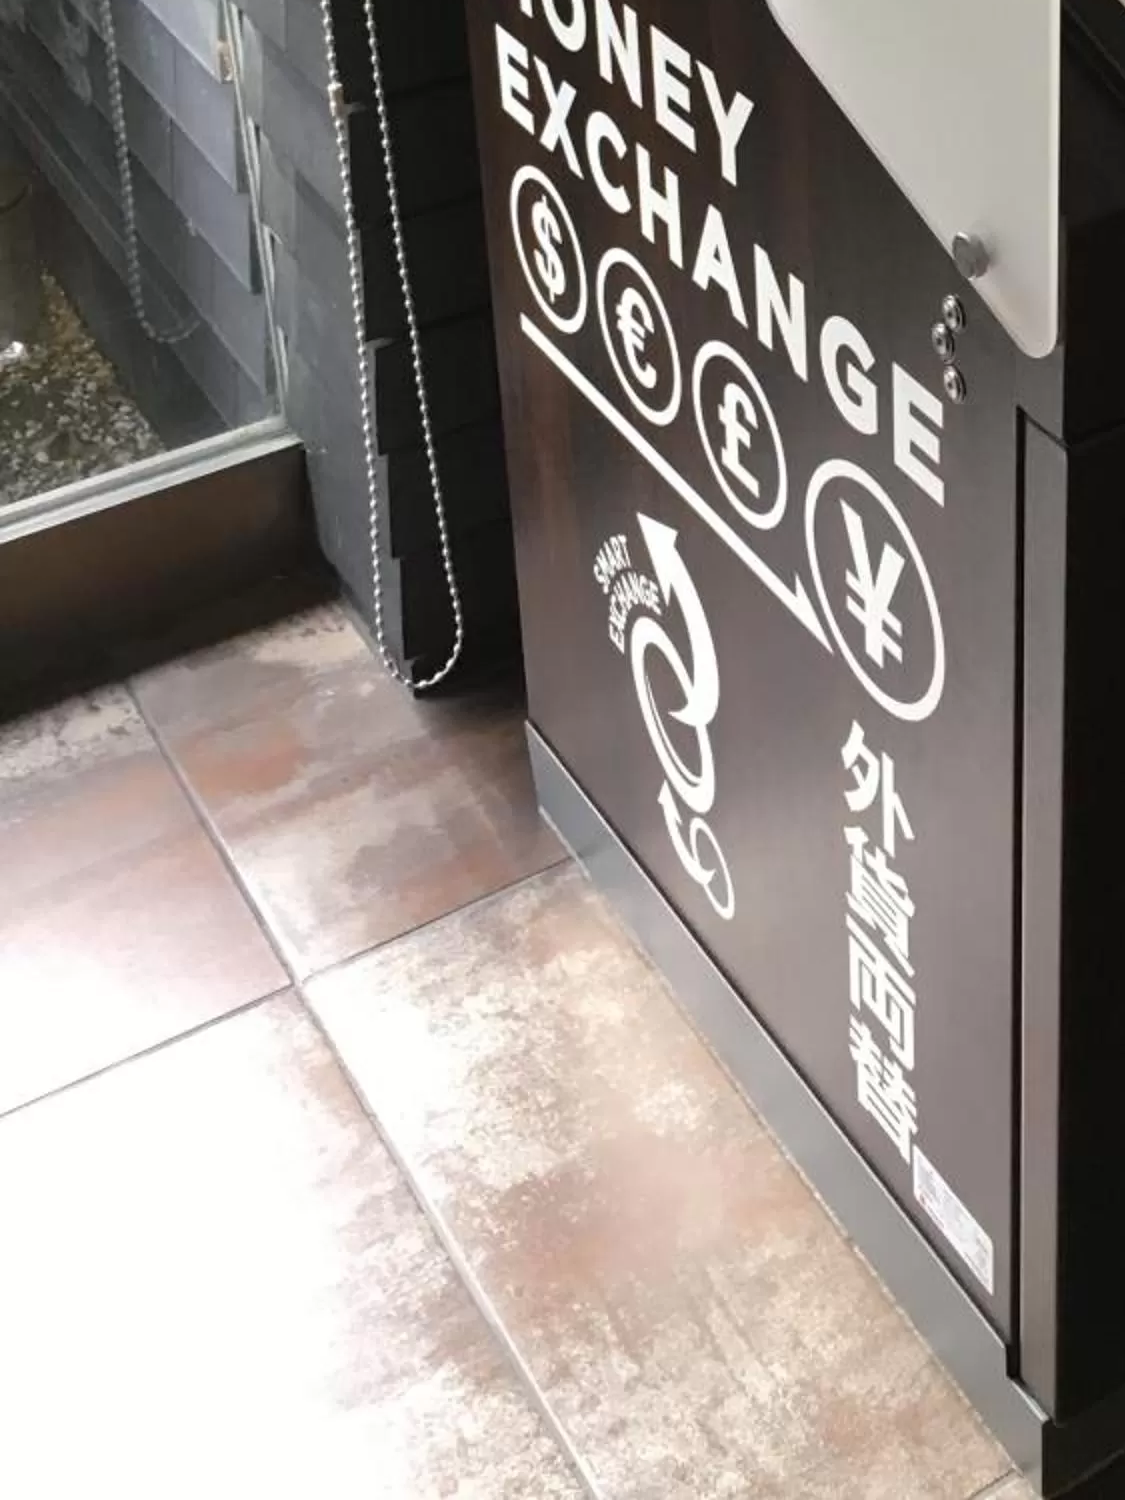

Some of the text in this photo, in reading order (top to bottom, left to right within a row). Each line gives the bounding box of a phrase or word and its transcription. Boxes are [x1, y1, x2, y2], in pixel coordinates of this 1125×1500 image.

[494, 23, 946, 508] EXCHANGE
[593, 534, 632, 595] SMART
[608, 571, 663, 655] EXCHANGE
[840, 720, 918, 1166] 外貨両替
